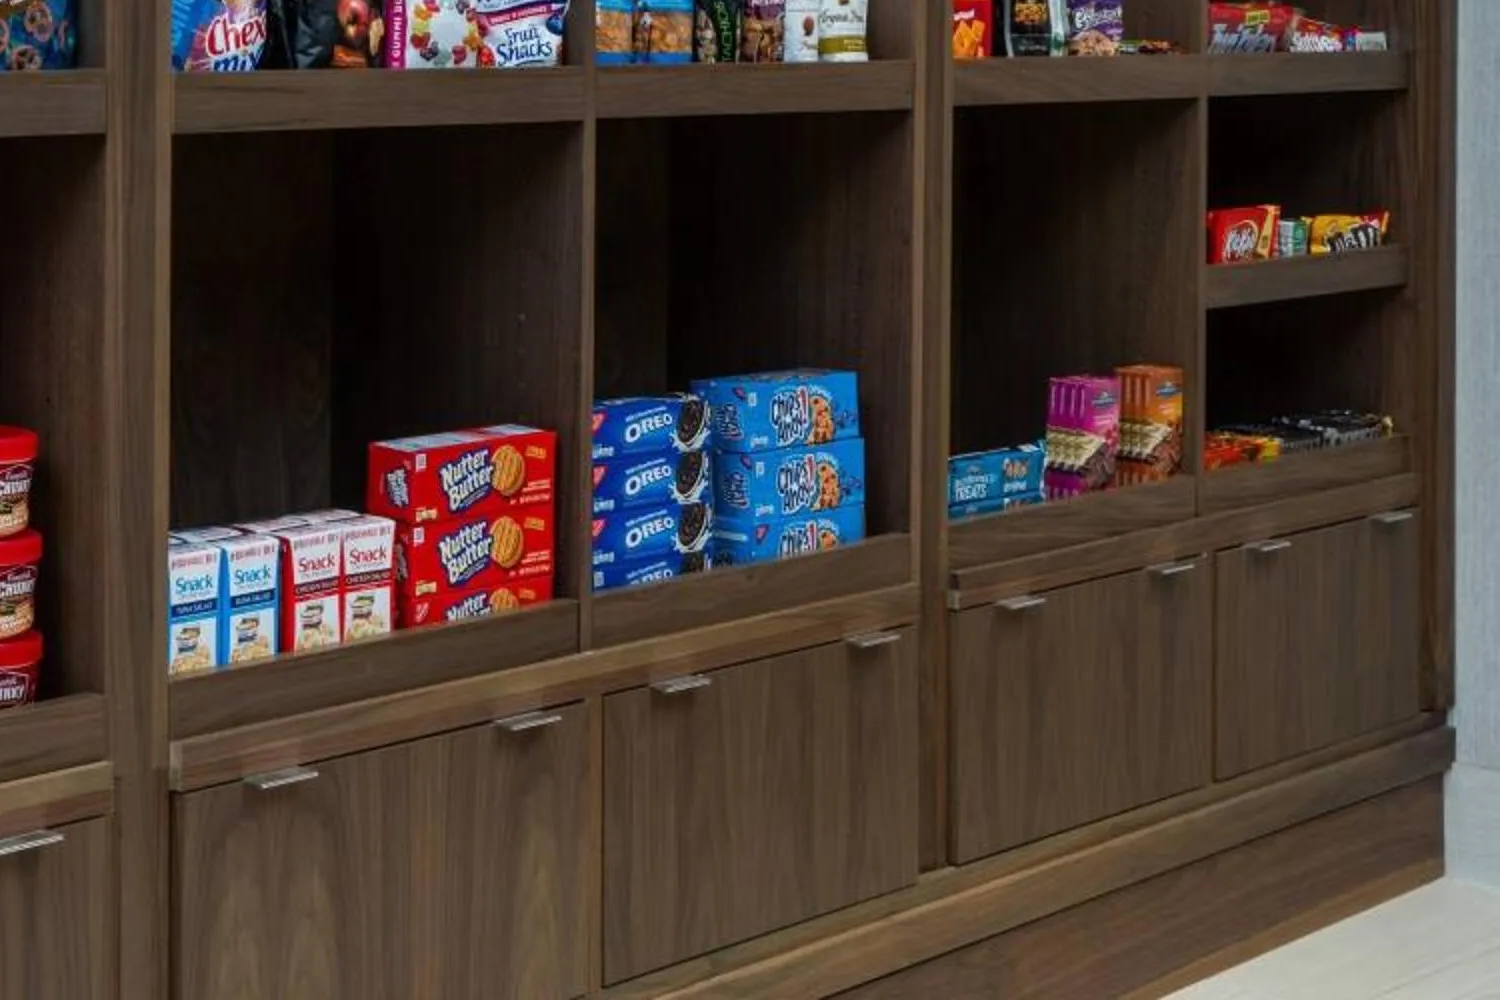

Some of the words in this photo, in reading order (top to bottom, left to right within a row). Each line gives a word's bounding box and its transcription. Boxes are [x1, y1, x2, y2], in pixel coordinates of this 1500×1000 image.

[206, 12, 266, 58] Chex
[504, 28, 541, 47] Fruit
[496, 40, 553, 67] Snacks
[625, 413, 673, 443] OREO
[439, 449, 489, 492] Nutter
[625, 465, 672, 495] OREO
[448, 465, 494, 511] Butter
[438, 521, 487, 564] Nutter
[625, 516, 675, 548] OREO
[299, 553, 336, 573] Snack
[350, 543, 387, 565] Snack
[447, 536, 492, 584] Butter
[175, 574, 213, 594] Snack
[234, 564, 271, 585] Snack
